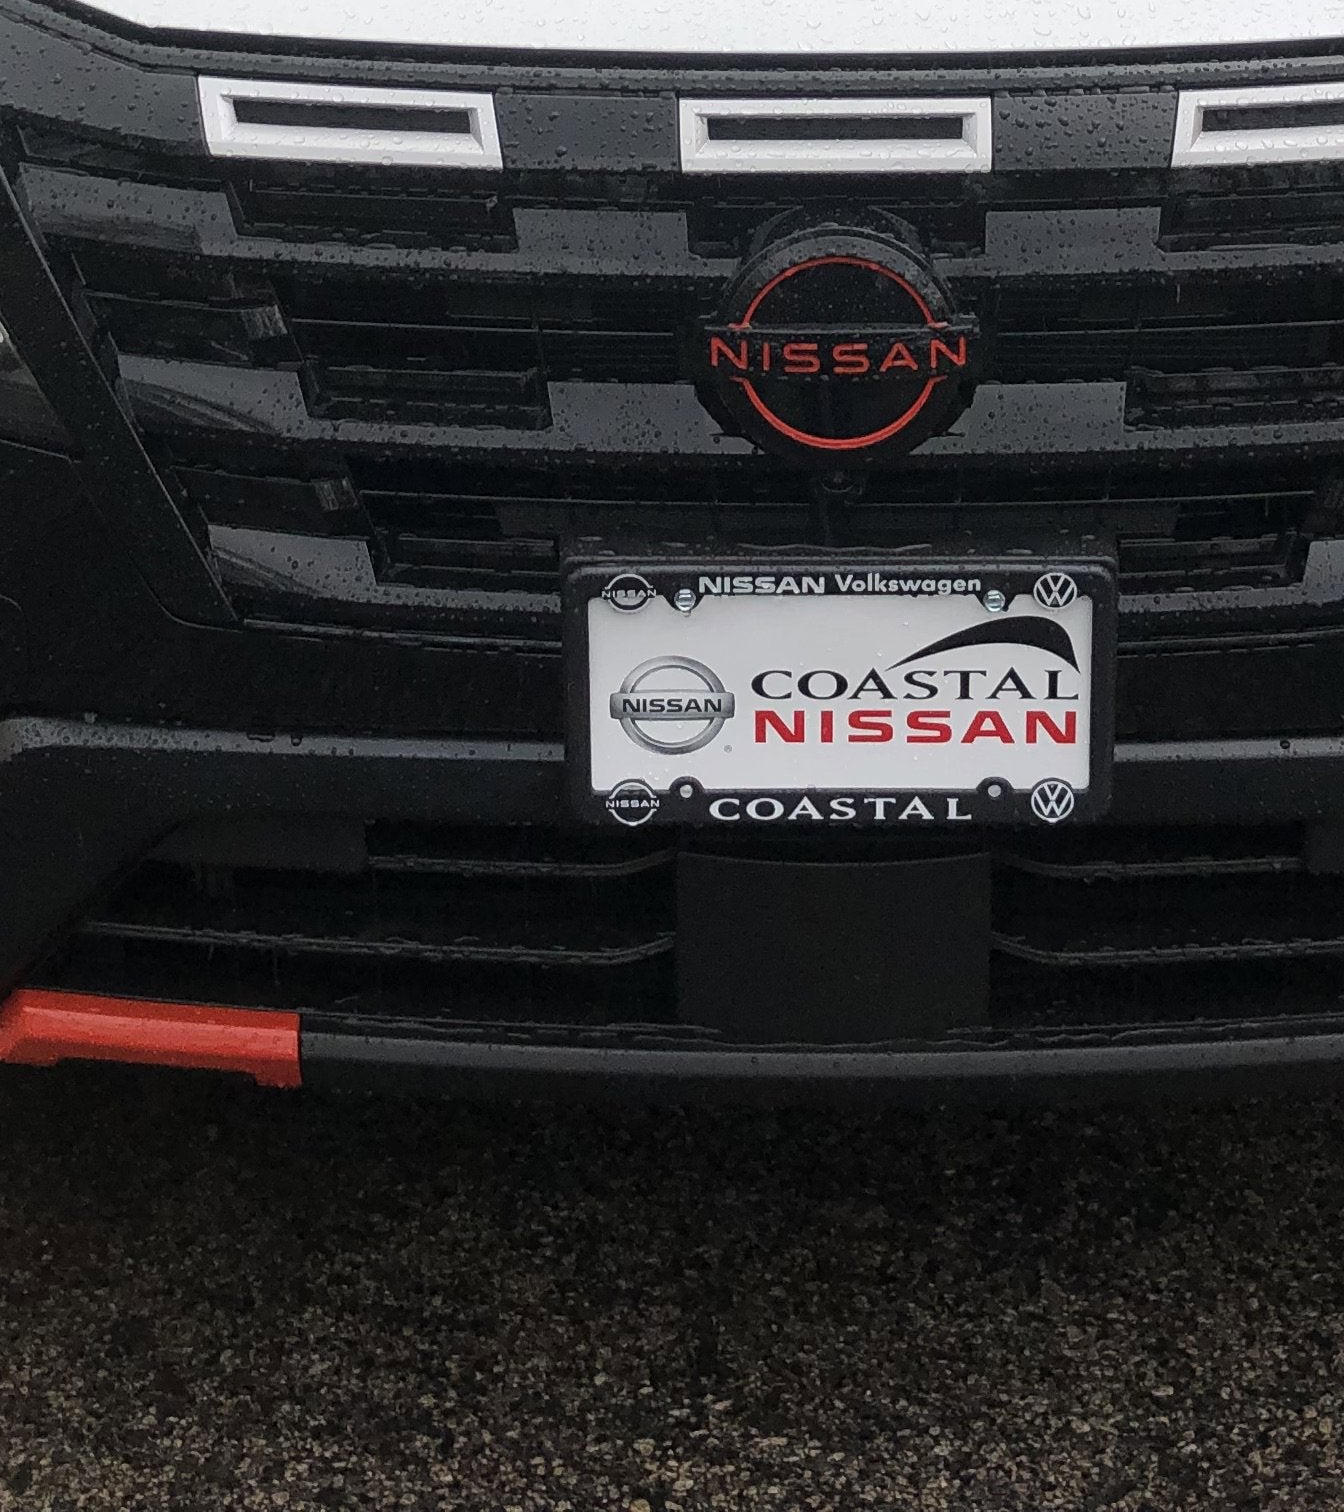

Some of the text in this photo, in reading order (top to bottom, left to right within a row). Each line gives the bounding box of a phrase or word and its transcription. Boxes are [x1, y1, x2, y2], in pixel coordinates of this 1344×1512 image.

[709, 336, 968, 373] NISSAN
[699, 573, 981, 595] NISSAN Volkswagen
[751, 667, 1079, 700] COASTAL
[622, 697, 723, 714] NISSAN
[754, 710, 1077, 744] NISSAN
[605, 799, 660, 808] NISSAN
[709, 797, 972, 821] COASTAL
